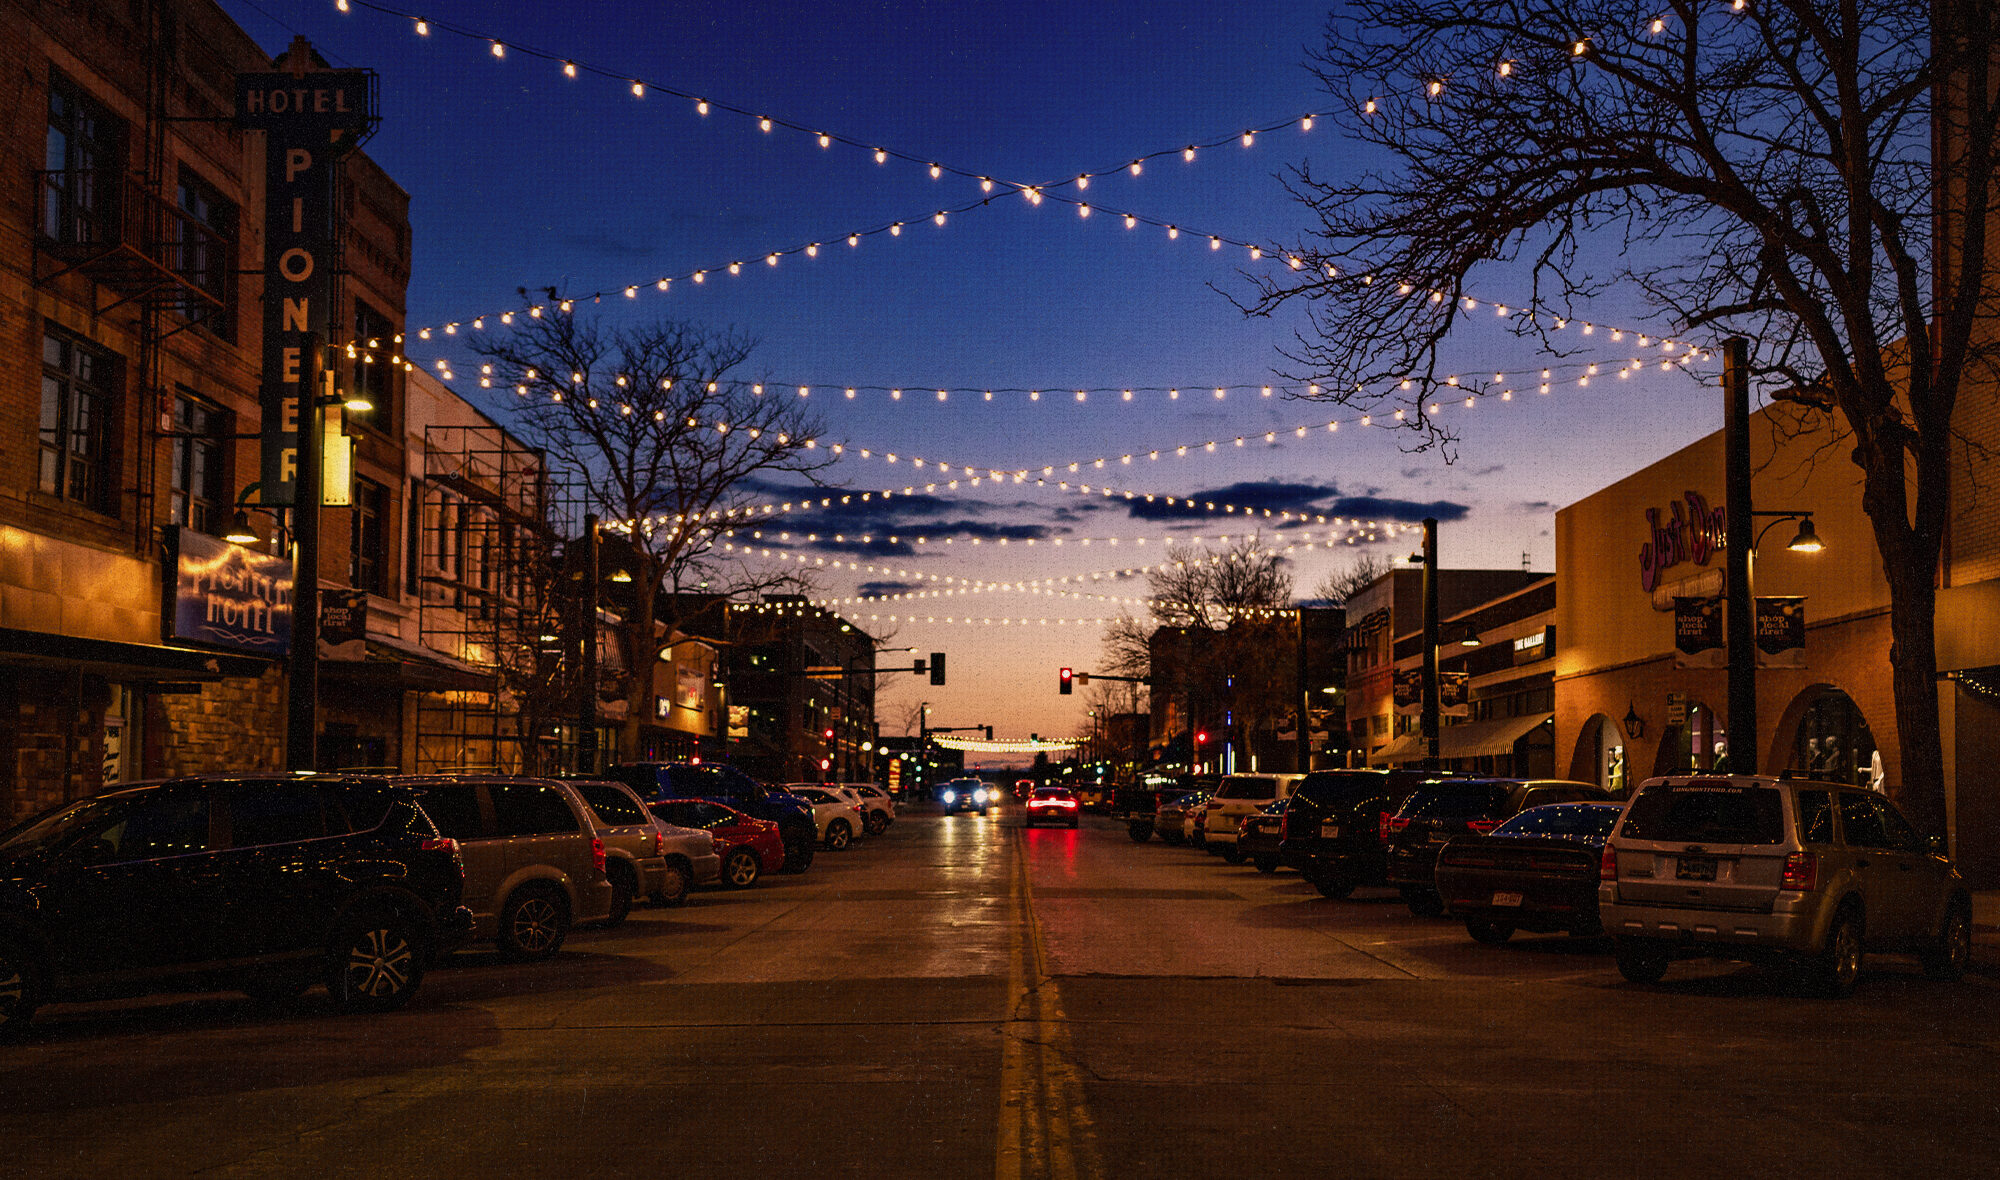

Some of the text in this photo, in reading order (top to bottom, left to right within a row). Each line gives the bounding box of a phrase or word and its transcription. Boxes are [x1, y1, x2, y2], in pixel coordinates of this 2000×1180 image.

[247, 88, 352, 113] HOTEL
[279, 148, 314, 483] PIONEER
[1639, 500, 1686, 593] Just
[192, 556, 290, 615] PIONEER
[206, 592, 275, 635] HOTEL
[1678, 615, 1703, 624] shop
[1759, 615, 1785, 624] shop
[1763, 621, 1789, 629] local
